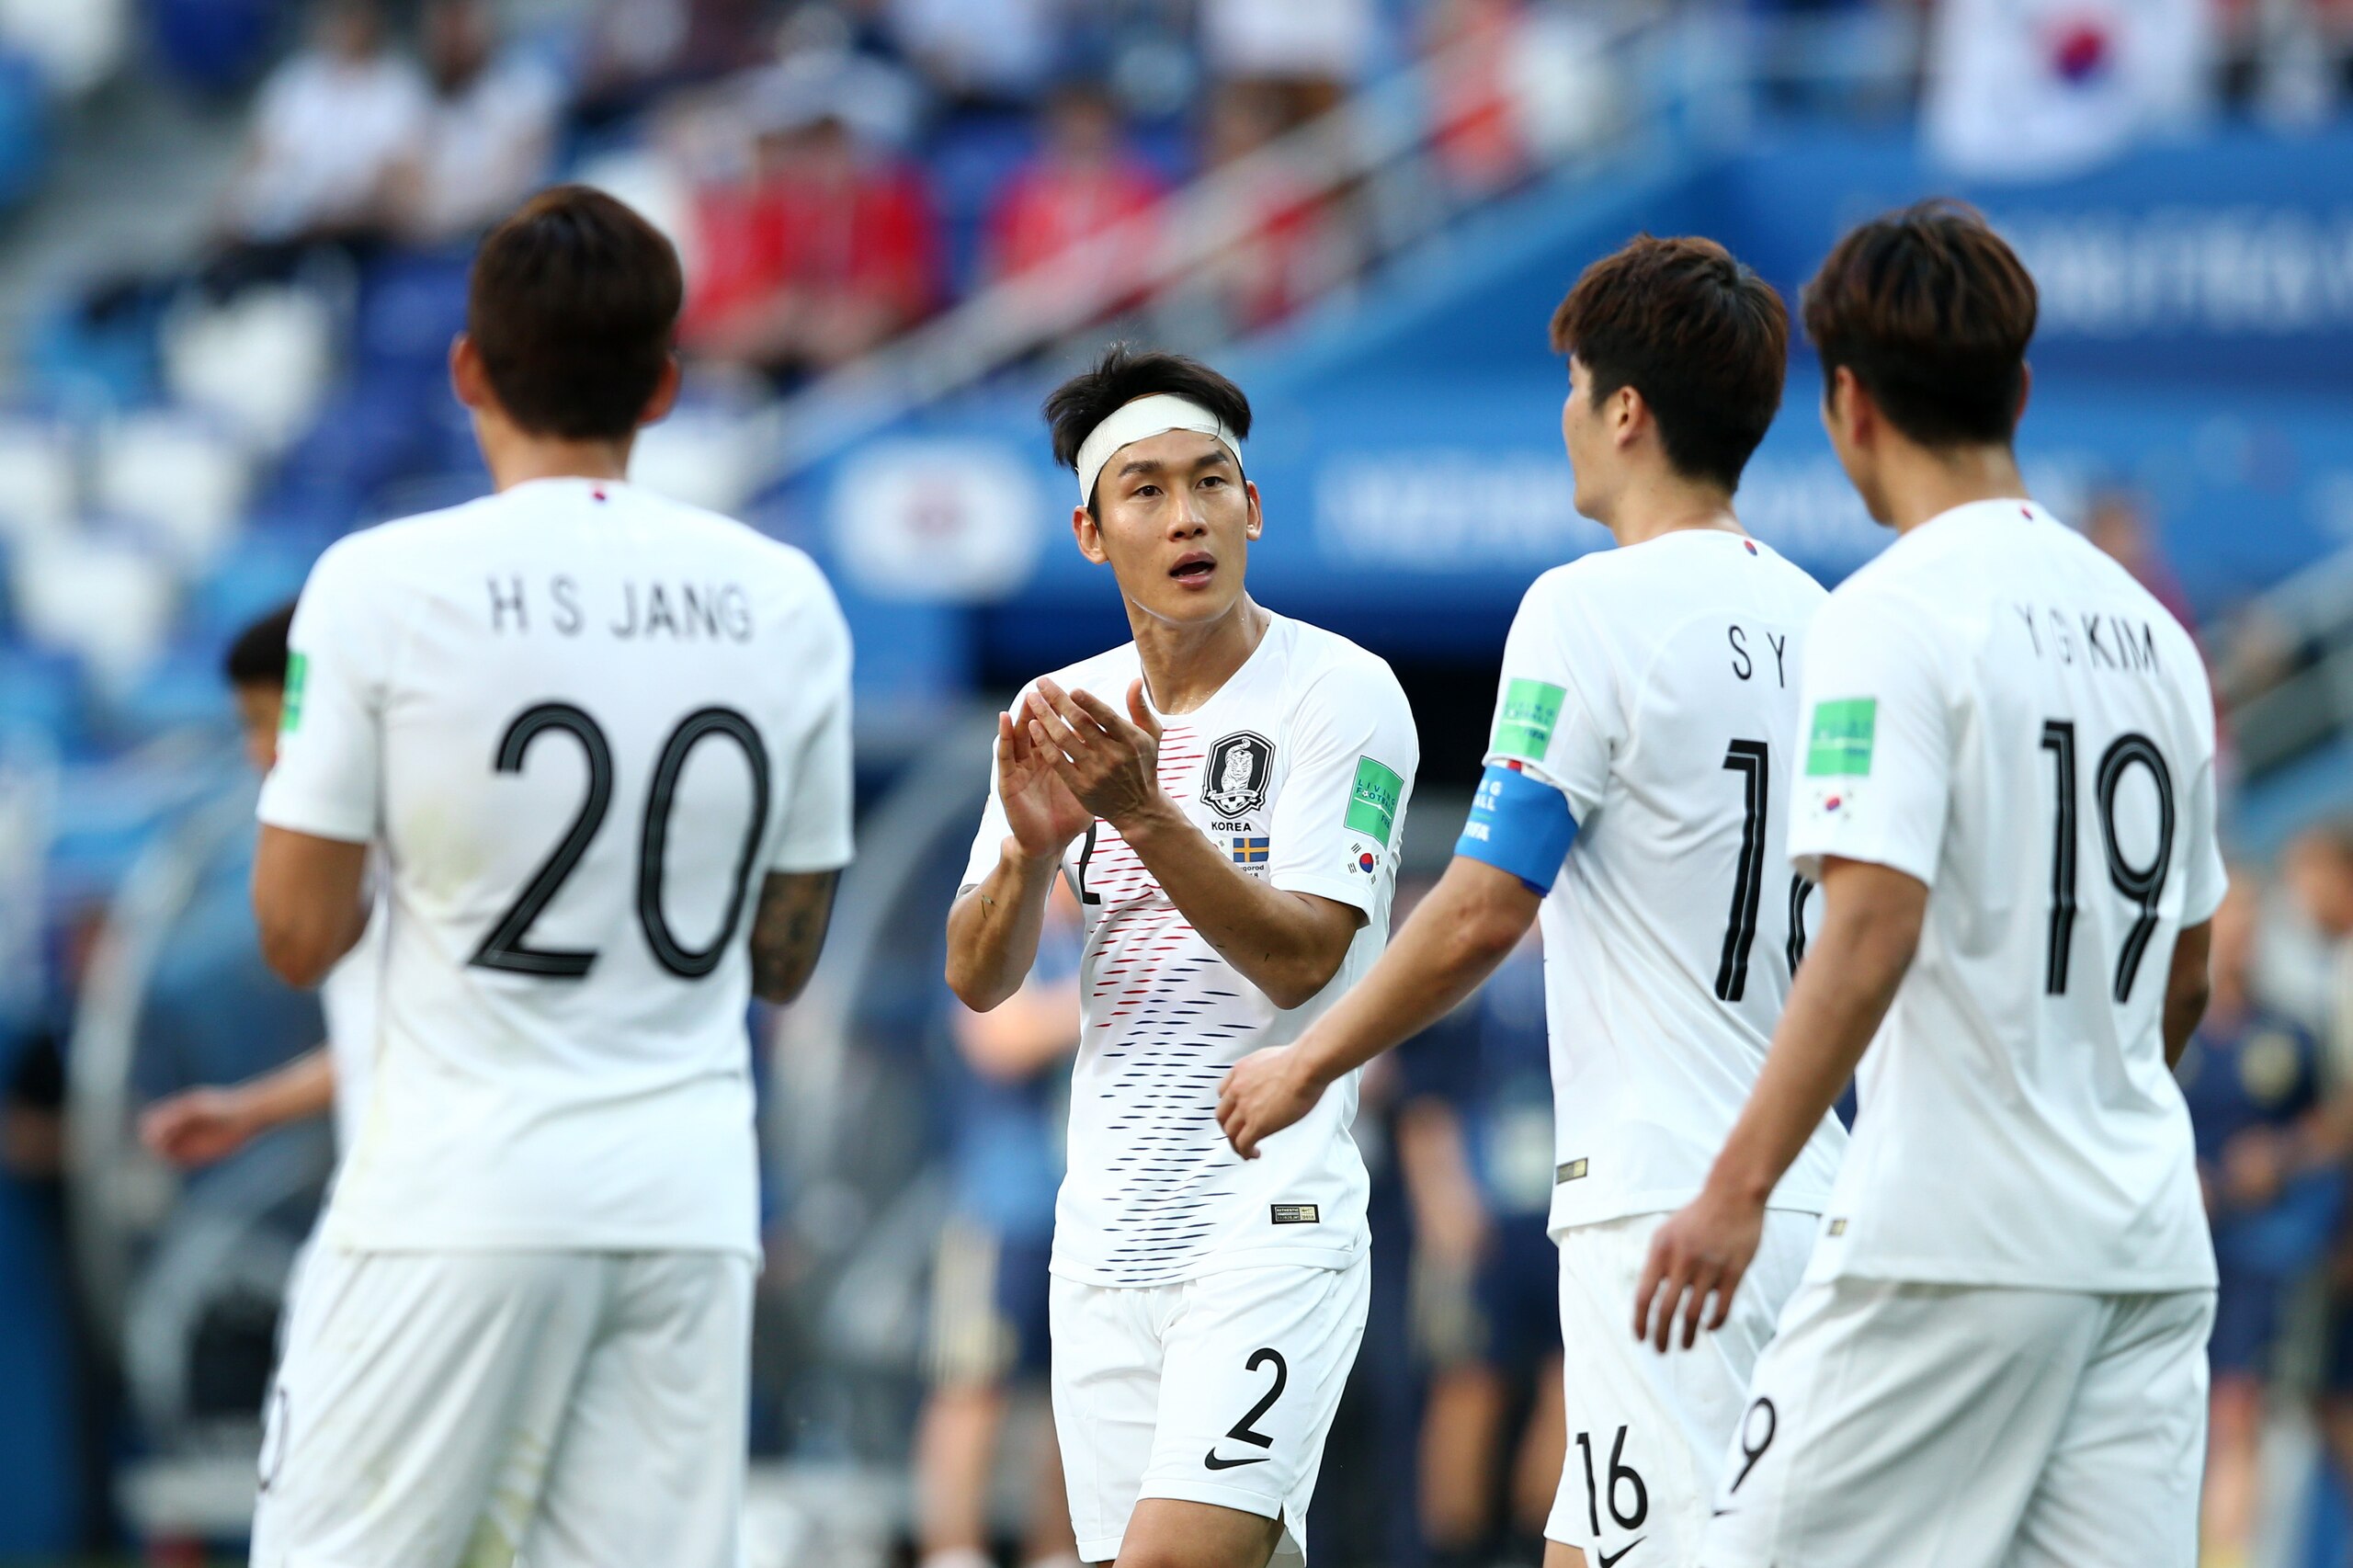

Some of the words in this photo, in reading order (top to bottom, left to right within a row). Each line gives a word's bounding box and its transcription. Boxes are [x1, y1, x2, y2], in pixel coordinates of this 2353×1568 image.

[487, 574, 529, 634] H
[551, 574, 585, 637] S
[608, 580, 755, 643] JANG
[2014, 602, 2041, 659] Y
[2080, 611, 2159, 674] KIM
[1728, 625, 1753, 680] S
[1767, 631, 1785, 688] Y
[1211, 821, 1252, 832] KOREA
[1358, 778, 1396, 806] LIVING
[467, 702, 769, 978] 20
[2040, 720, 2175, 1004] 19
[1225, 1347, 1288, 1449] 2
[1575, 1425, 1648, 1537] 16
[1730, 1396, 1778, 1495] 9
